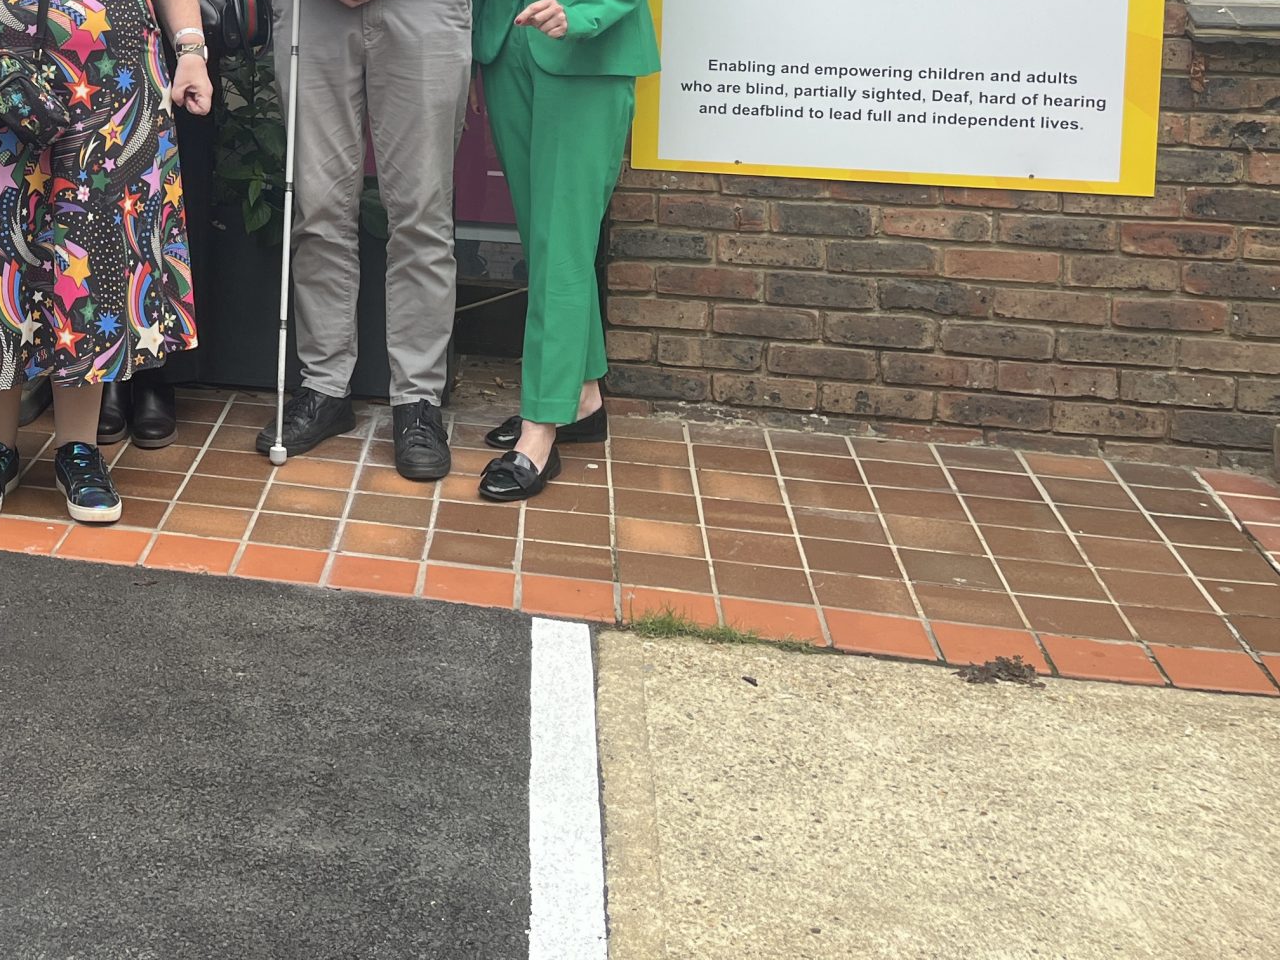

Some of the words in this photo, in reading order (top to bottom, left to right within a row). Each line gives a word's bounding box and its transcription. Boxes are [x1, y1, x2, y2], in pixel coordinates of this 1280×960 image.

[708, 59, 776, 77] Enabling
[780, 62, 809, 75] and
[814, 64, 913, 82] empowering
[918, 66, 985, 81] children
[990, 69, 1021, 83] and
[1026, 71, 1078, 85] adults
[680, 80, 713, 93] who
[717, 83, 741, 94] are
[745, 82, 788, 97] blind,
[793, 84, 857, 102] partially
[861, 87, 926, 104] sighted,
[931, 89, 972, 105] Deaf,
[979, 91, 1015, 106] hard
[1019, 93, 1039, 107] of
[1043, 94, 1107, 112] hearing
[699, 102, 727, 115] and
[732, 103, 804, 119] deafblind
[808, 106, 825, 120] to
[829, 107, 862, 121] lead
[866, 109, 892, 122] full
[897, 111, 927, 124] and
[932, 112, 1036, 130] independent
[1040, 115, 1084, 131] lives.
